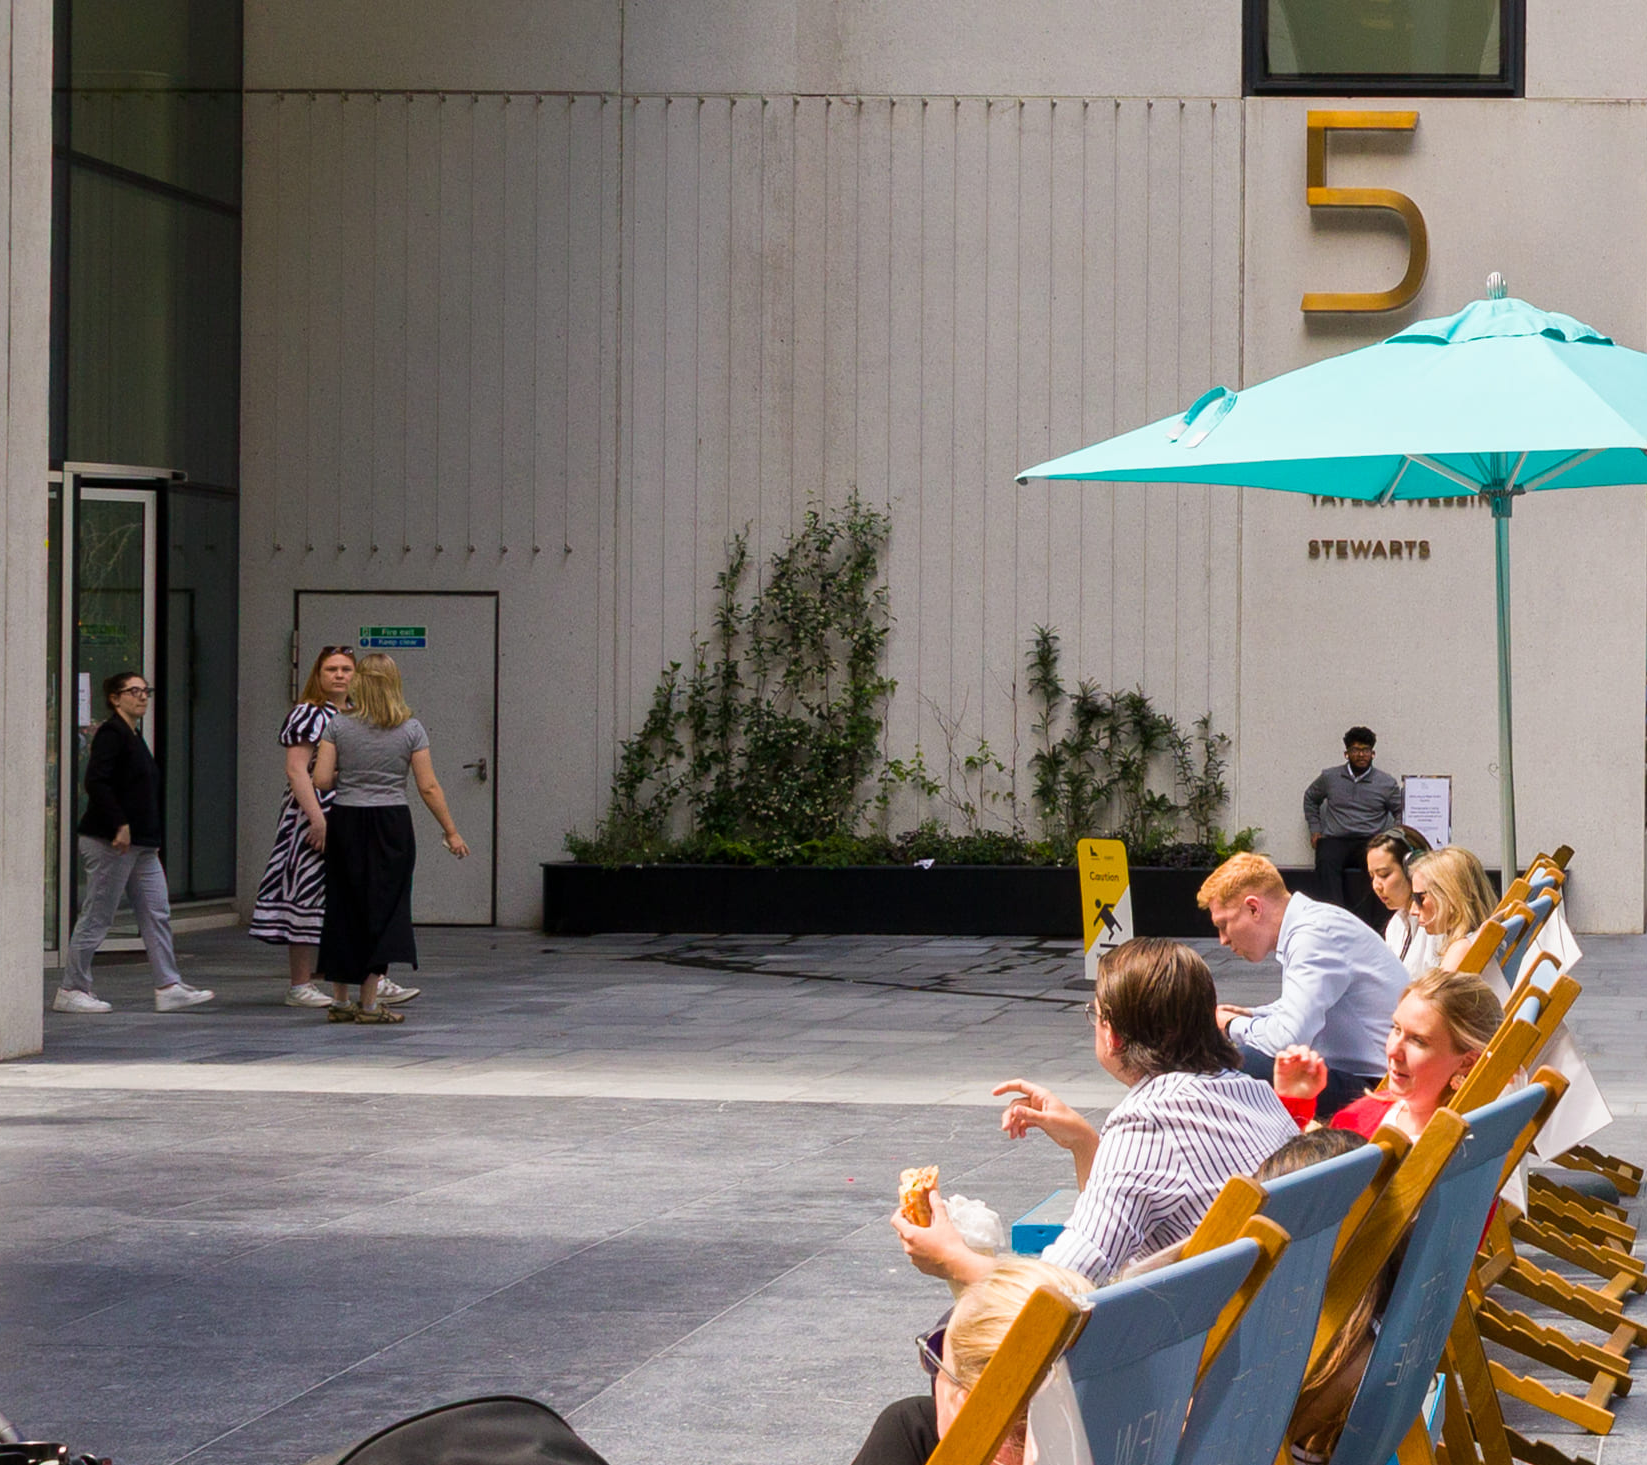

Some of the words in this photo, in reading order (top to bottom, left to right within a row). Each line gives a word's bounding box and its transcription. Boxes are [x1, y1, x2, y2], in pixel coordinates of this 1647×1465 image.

[1301, 110, 1430, 313] 5
[1307, 539, 1431, 559] STEWARTS
[1089, 871, 1120, 882] Caution
